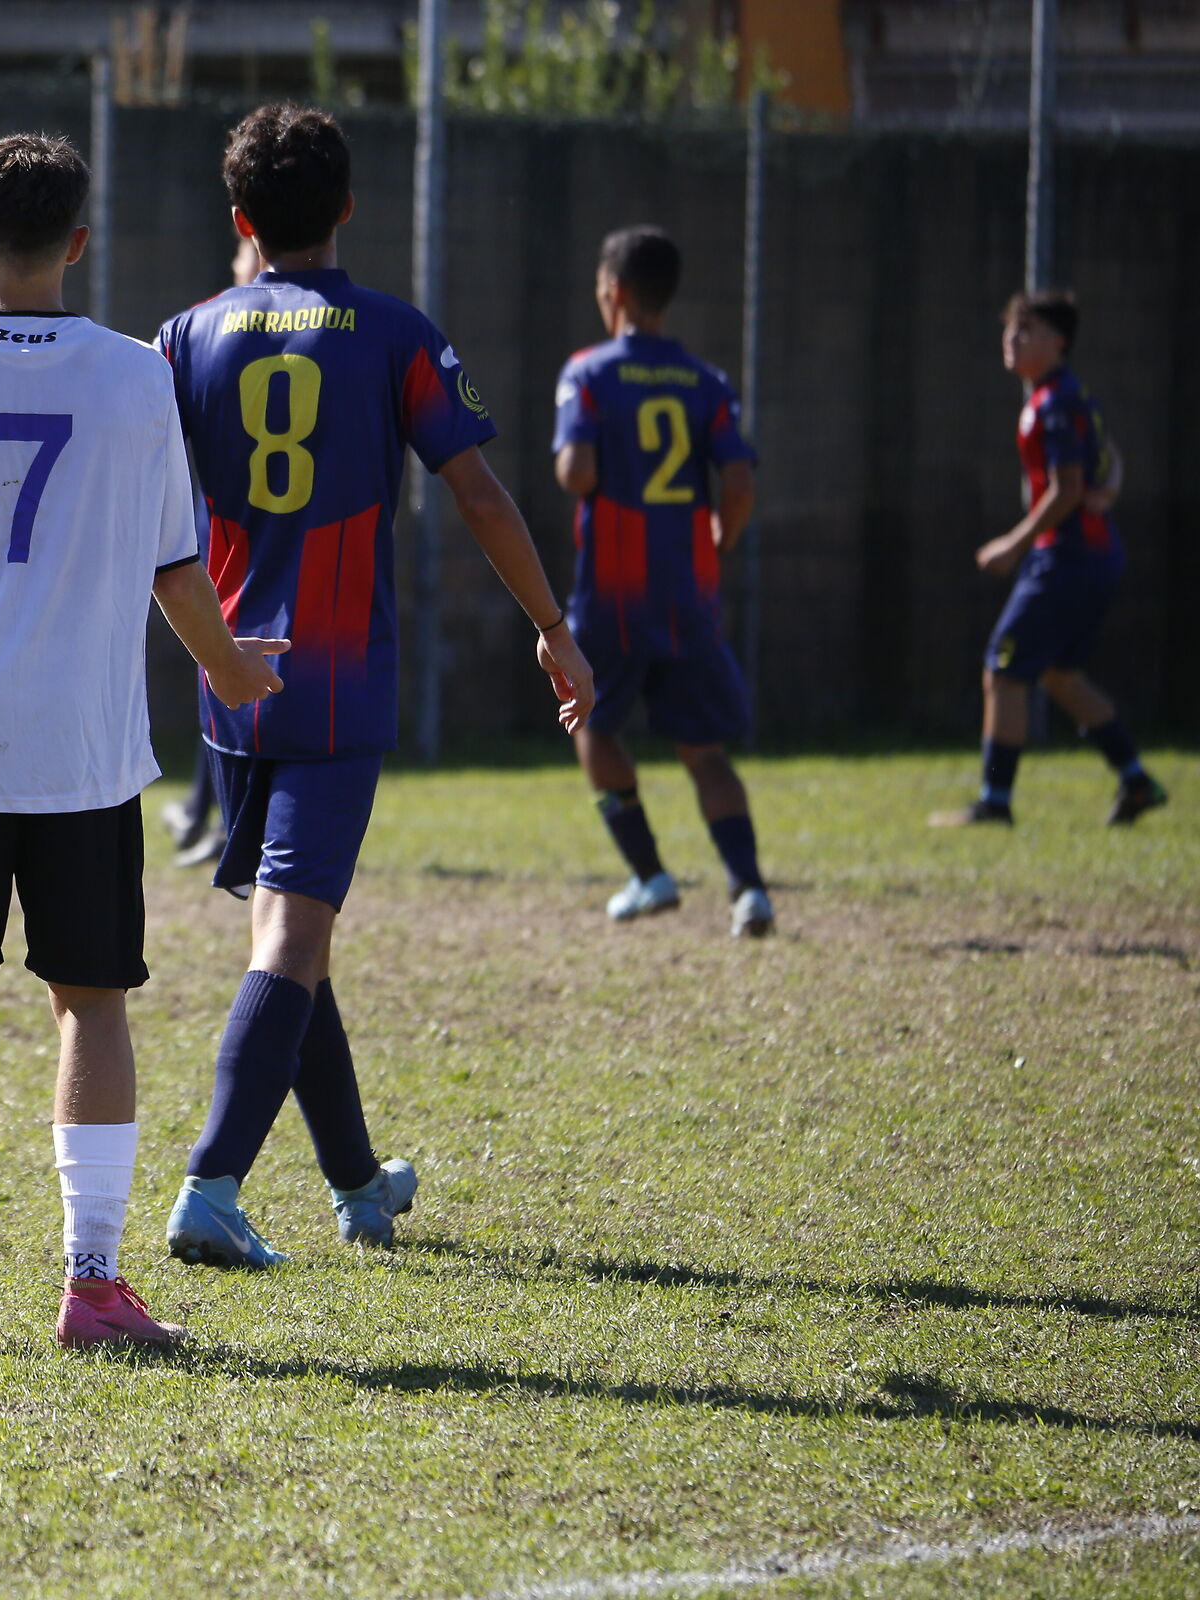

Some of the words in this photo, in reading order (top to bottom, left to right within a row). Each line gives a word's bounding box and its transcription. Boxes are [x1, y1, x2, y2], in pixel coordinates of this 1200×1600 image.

[222, 307, 356, 335] BARRACUDA
[239, 353, 322, 514] 8
[638, 397, 694, 504] 2
